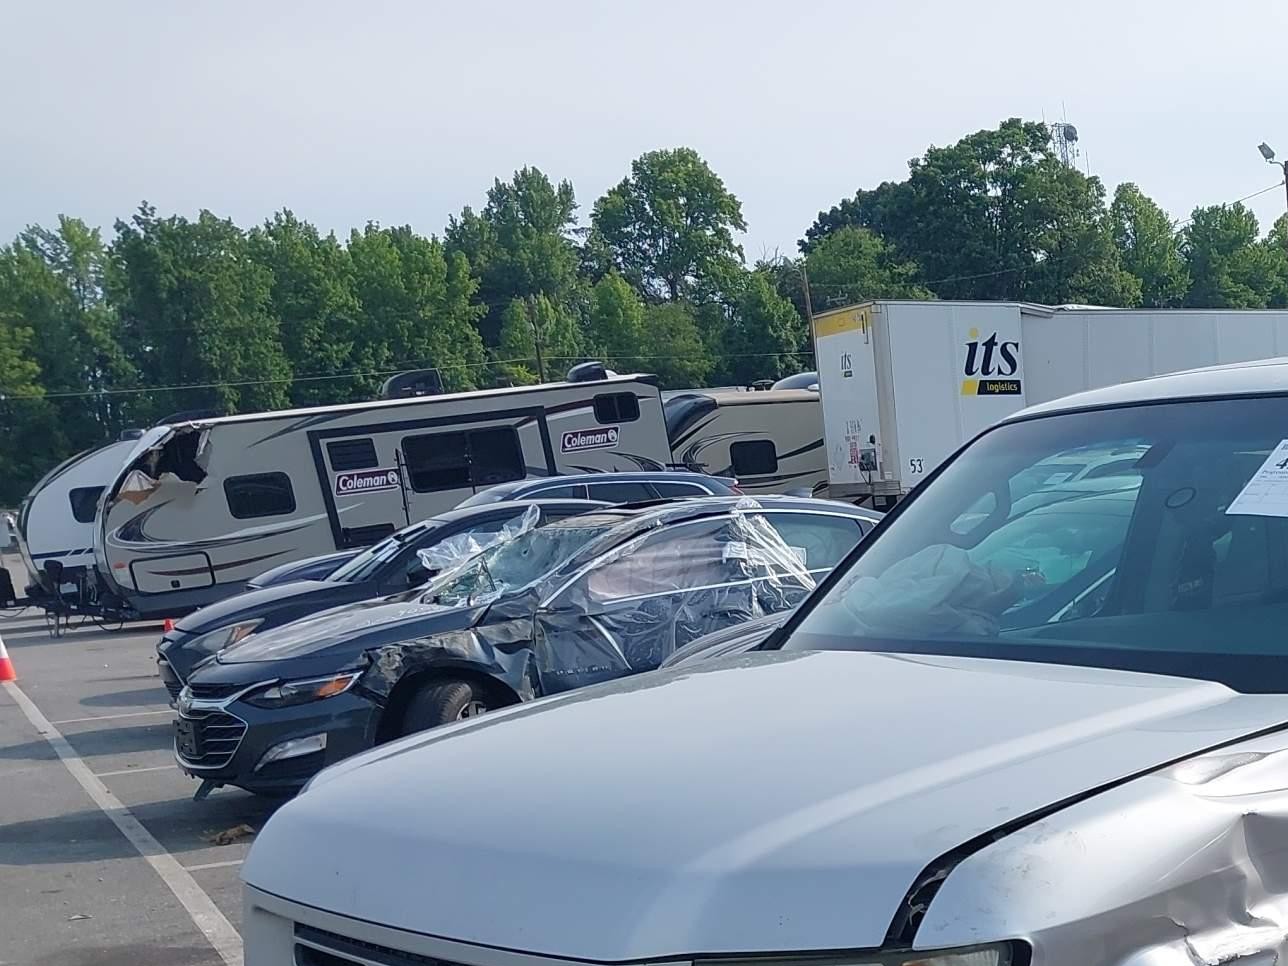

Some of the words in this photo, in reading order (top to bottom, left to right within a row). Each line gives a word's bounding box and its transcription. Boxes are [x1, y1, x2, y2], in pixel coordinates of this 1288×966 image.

[964, 328, 1019, 376] its
[986, 382, 1018, 393] logistics
[564, 432, 608, 448] Coleman
[338, 473, 387, 490] Coleman
